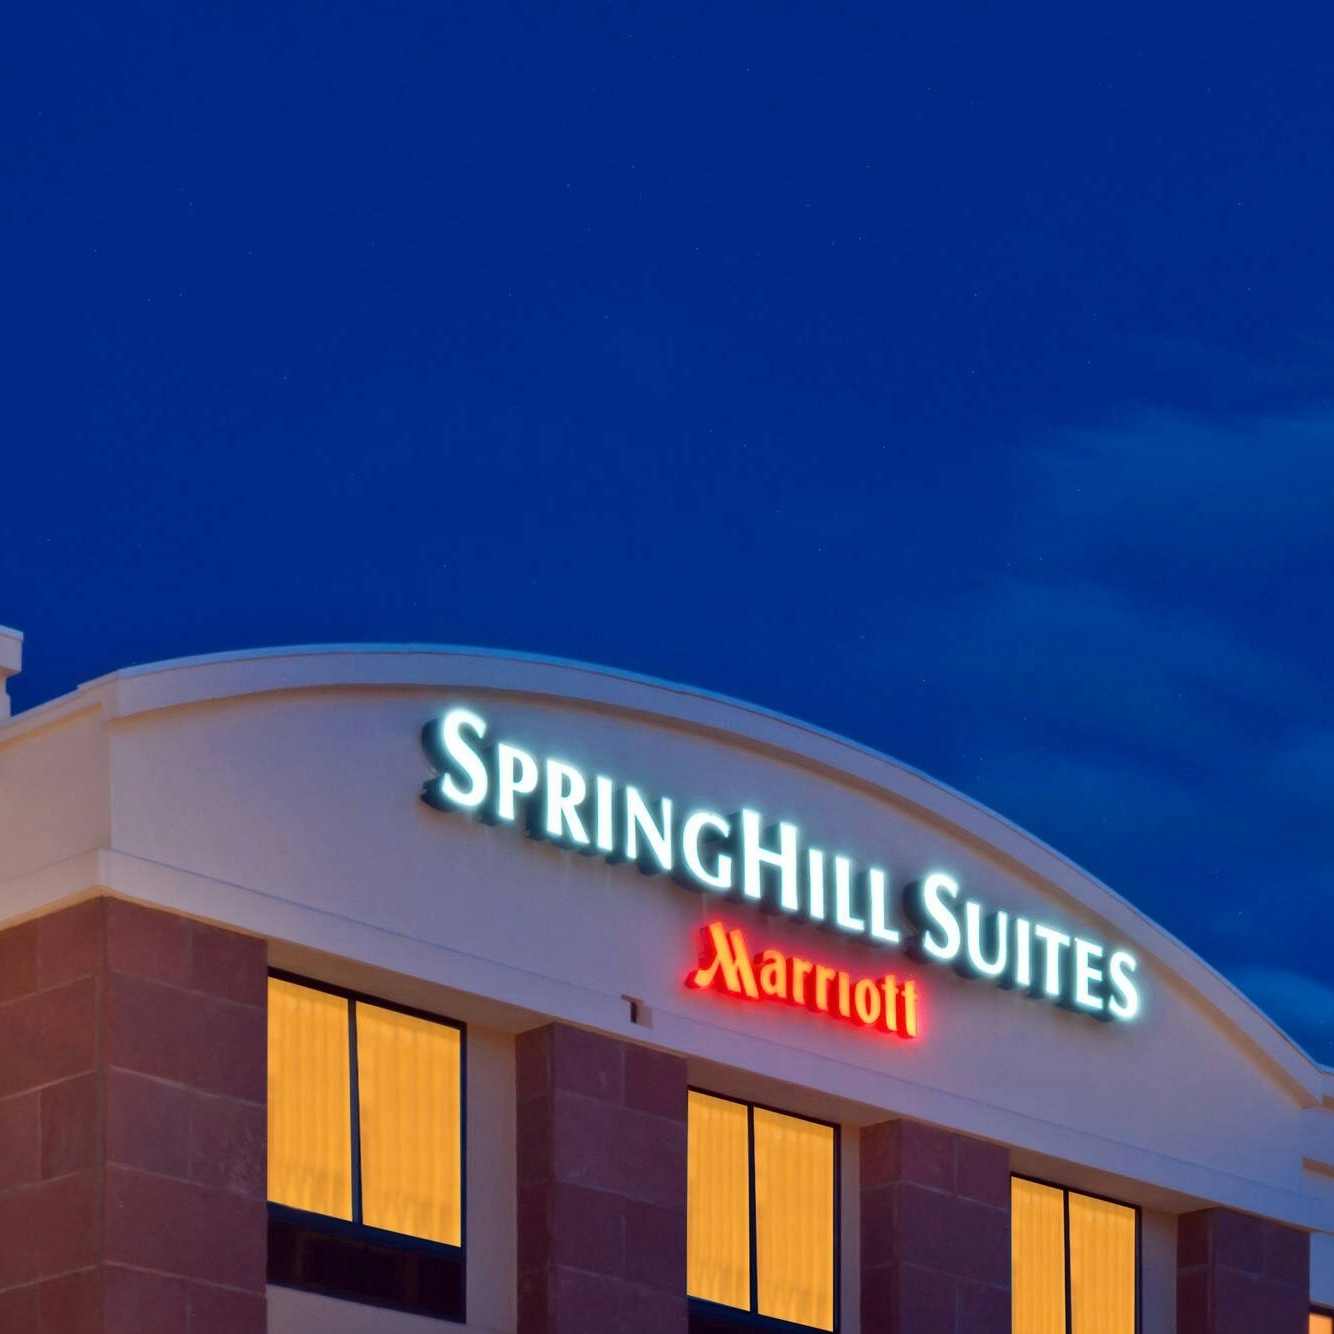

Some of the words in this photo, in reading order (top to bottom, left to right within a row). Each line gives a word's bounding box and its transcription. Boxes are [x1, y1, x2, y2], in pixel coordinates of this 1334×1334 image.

[435, 706, 901, 945] SPRINGHILL
[920, 870, 1141, 1021] SUITES
[689, 920, 919, 1038] Marriott
